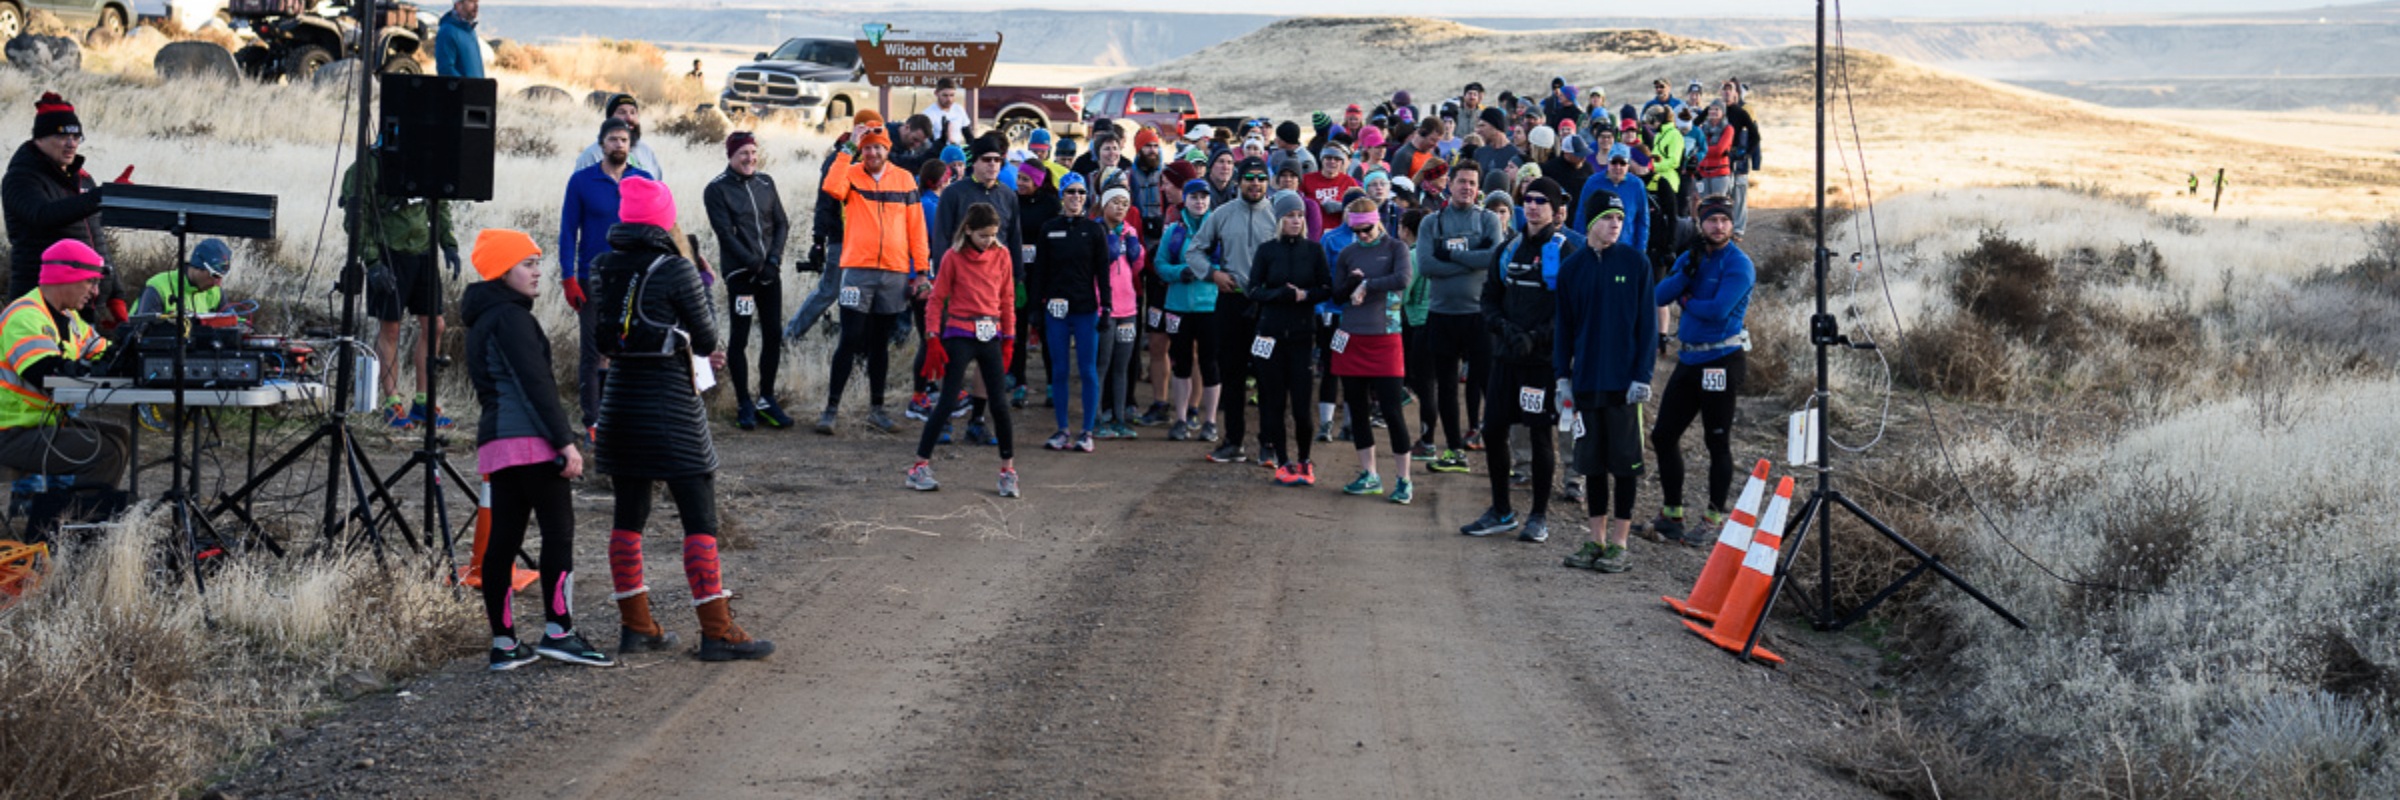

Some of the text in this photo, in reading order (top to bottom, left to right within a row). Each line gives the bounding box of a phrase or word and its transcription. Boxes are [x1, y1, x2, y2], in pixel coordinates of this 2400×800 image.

[884, 43, 968, 58] Wilson Creek
[897, 57, 955, 73] Trailhead
[888, 75, 915, 85] BOISE
[1703, 373, 1726, 390] 550
